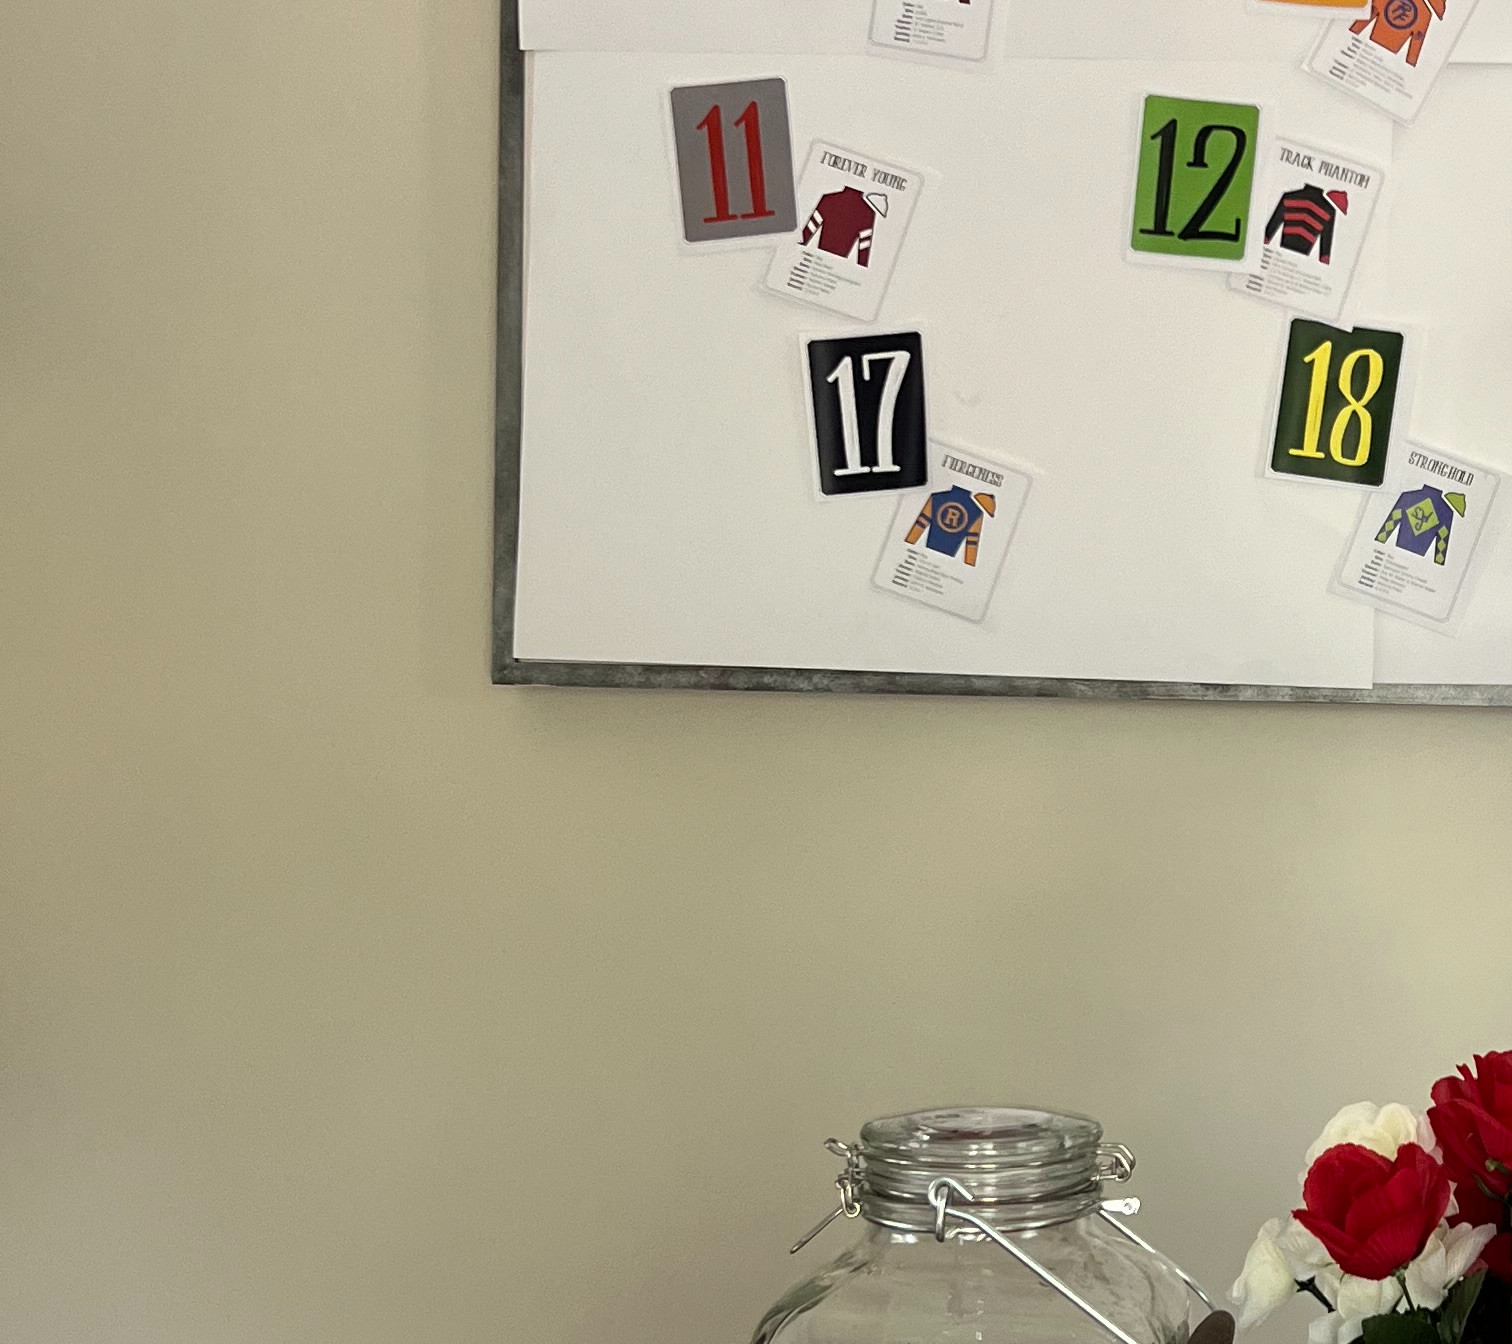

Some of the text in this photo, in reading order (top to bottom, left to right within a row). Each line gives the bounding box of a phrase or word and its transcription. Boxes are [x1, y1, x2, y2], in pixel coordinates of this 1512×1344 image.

[696, 101, 775, 223] 11
[820, 151, 907, 192] FOREVER YOUNG
[1140, 117, 1247, 242] 12
[1279, 147, 1371, 189] TRACK PHANTOM
[826, 350, 911, 476] 17
[1288, 340, 1384, 466] 18
[1408, 451, 1474, 486] STRONGHOLD
[946, 508, 960, 527] R
